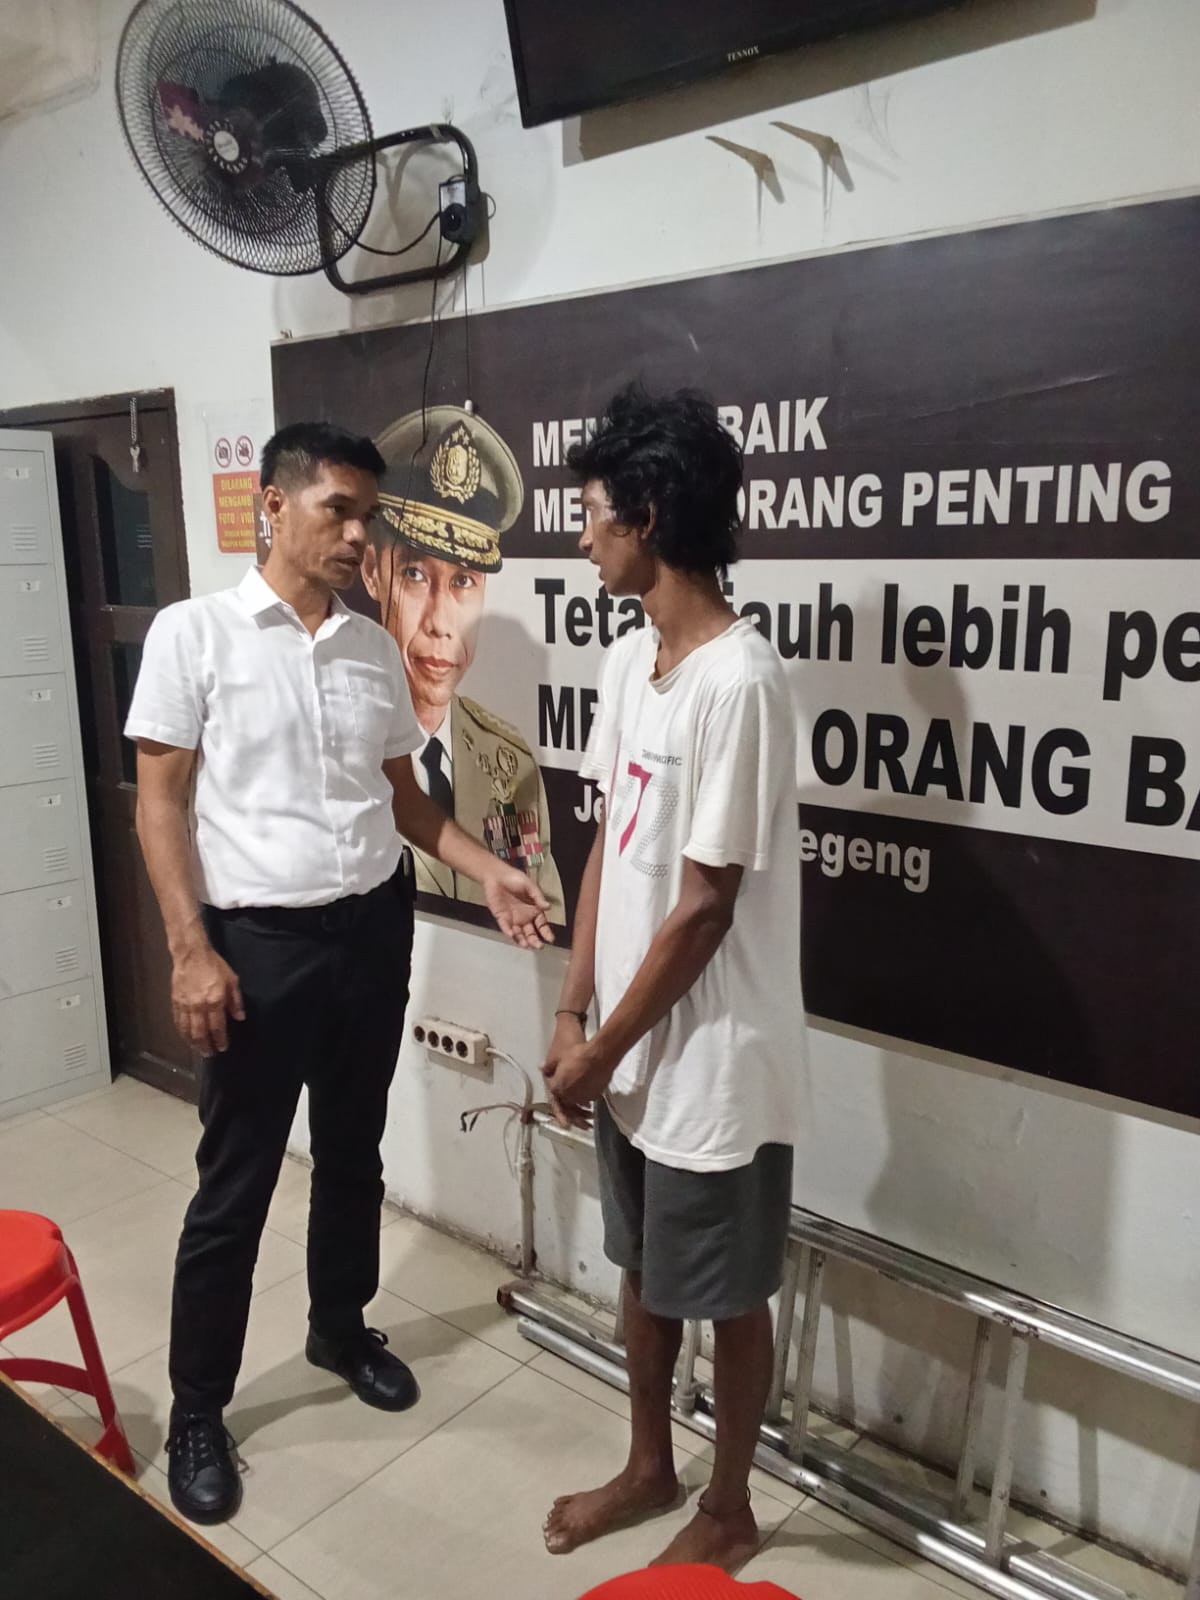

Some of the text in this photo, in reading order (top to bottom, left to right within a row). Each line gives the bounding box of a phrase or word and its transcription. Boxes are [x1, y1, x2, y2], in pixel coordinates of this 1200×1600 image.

[534, 487, 592, 533] ME
[901, 460, 1172, 526] PENTING
[534, 578, 1200, 701] Teta auh lebih pe
[811, 708, 1091, 816] ORANG
[1125, 735, 1200, 832] B
[800, 829, 930, 893] egeng
